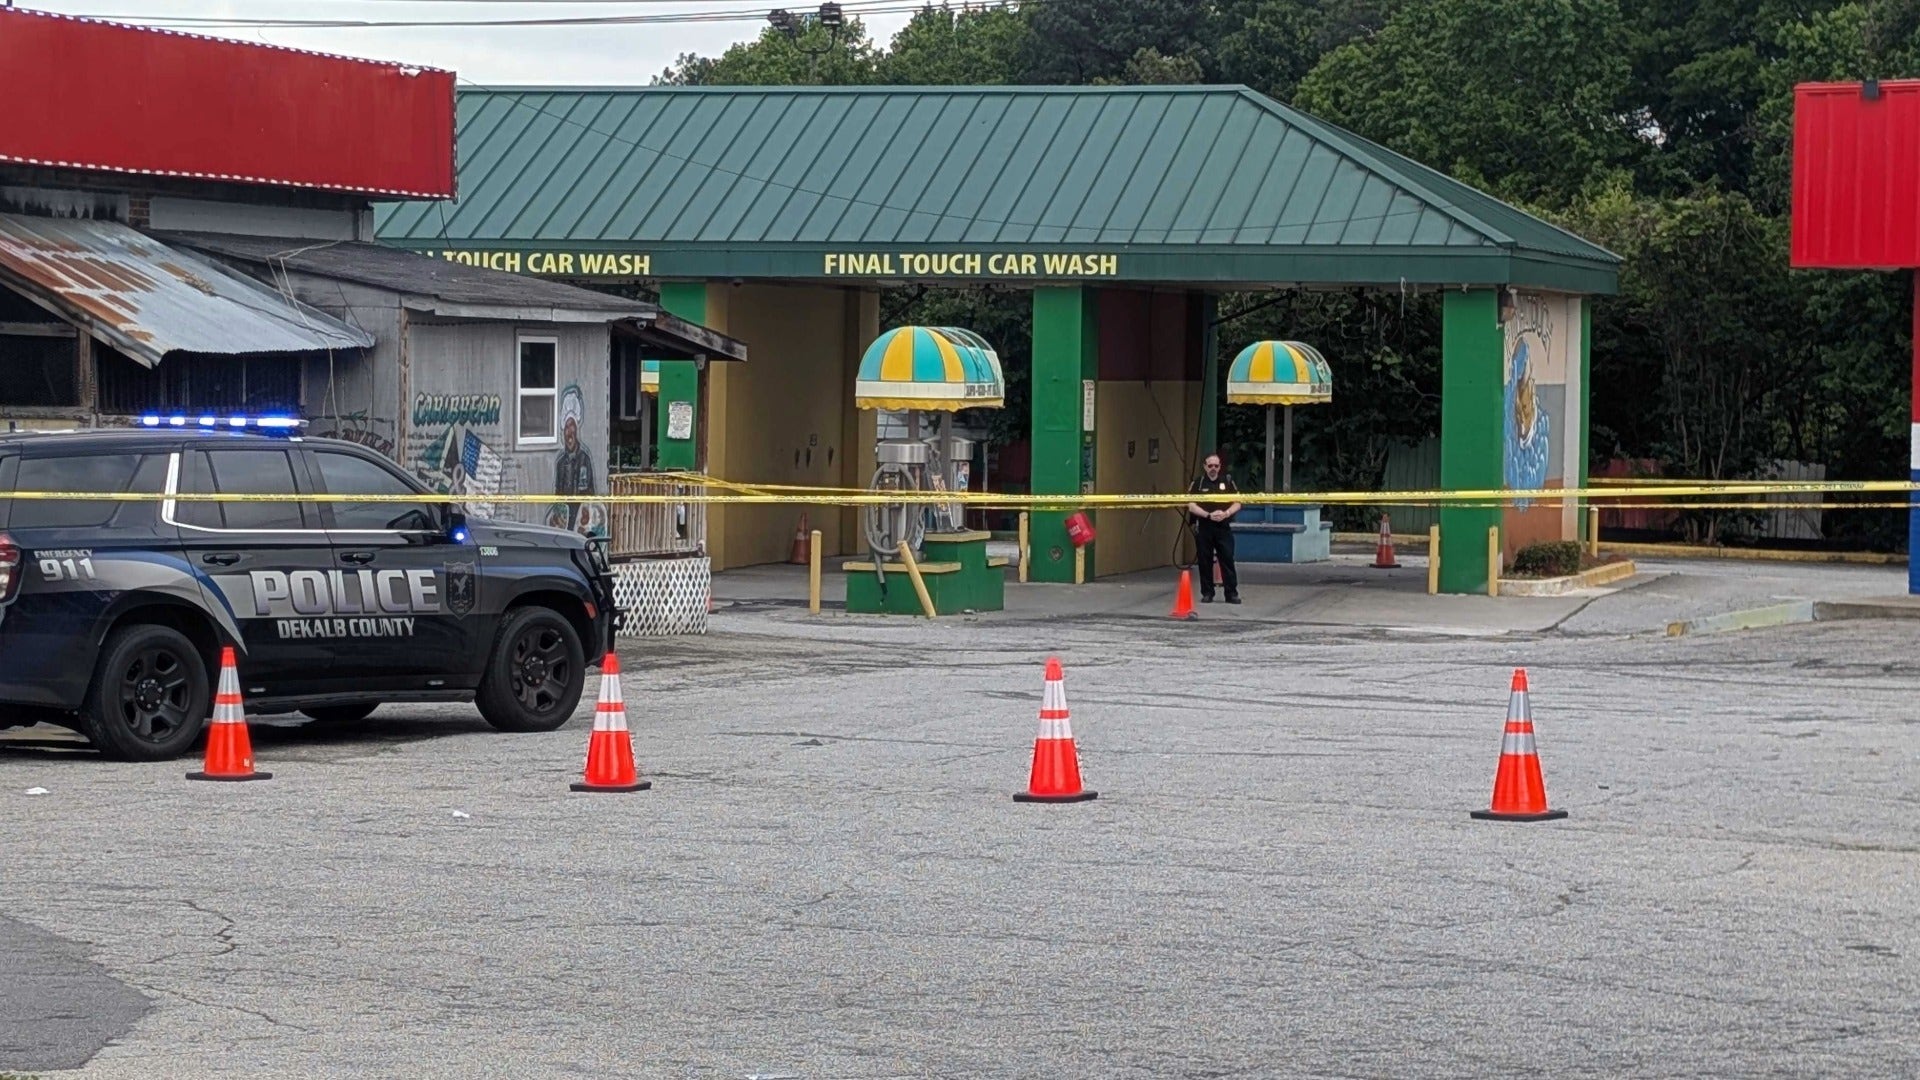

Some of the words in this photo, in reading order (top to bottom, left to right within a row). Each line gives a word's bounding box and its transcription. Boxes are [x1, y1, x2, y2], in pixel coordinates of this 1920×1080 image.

[527, 252, 573, 273] CAR
[580, 254, 650, 275] WASH
[824, 254, 895, 274] FINAL
[900, 254, 981, 275] TOUCH
[988, 254, 1036, 275] CAR
[1043, 254, 1118, 275] WASH
[33, 548, 92, 558] EMERGENCY
[39, 558, 96, 582] 911
[249, 569, 441, 616] POLICE
[277, 618, 346, 639] DEKALB
[349, 617, 415, 638] COUNTY
